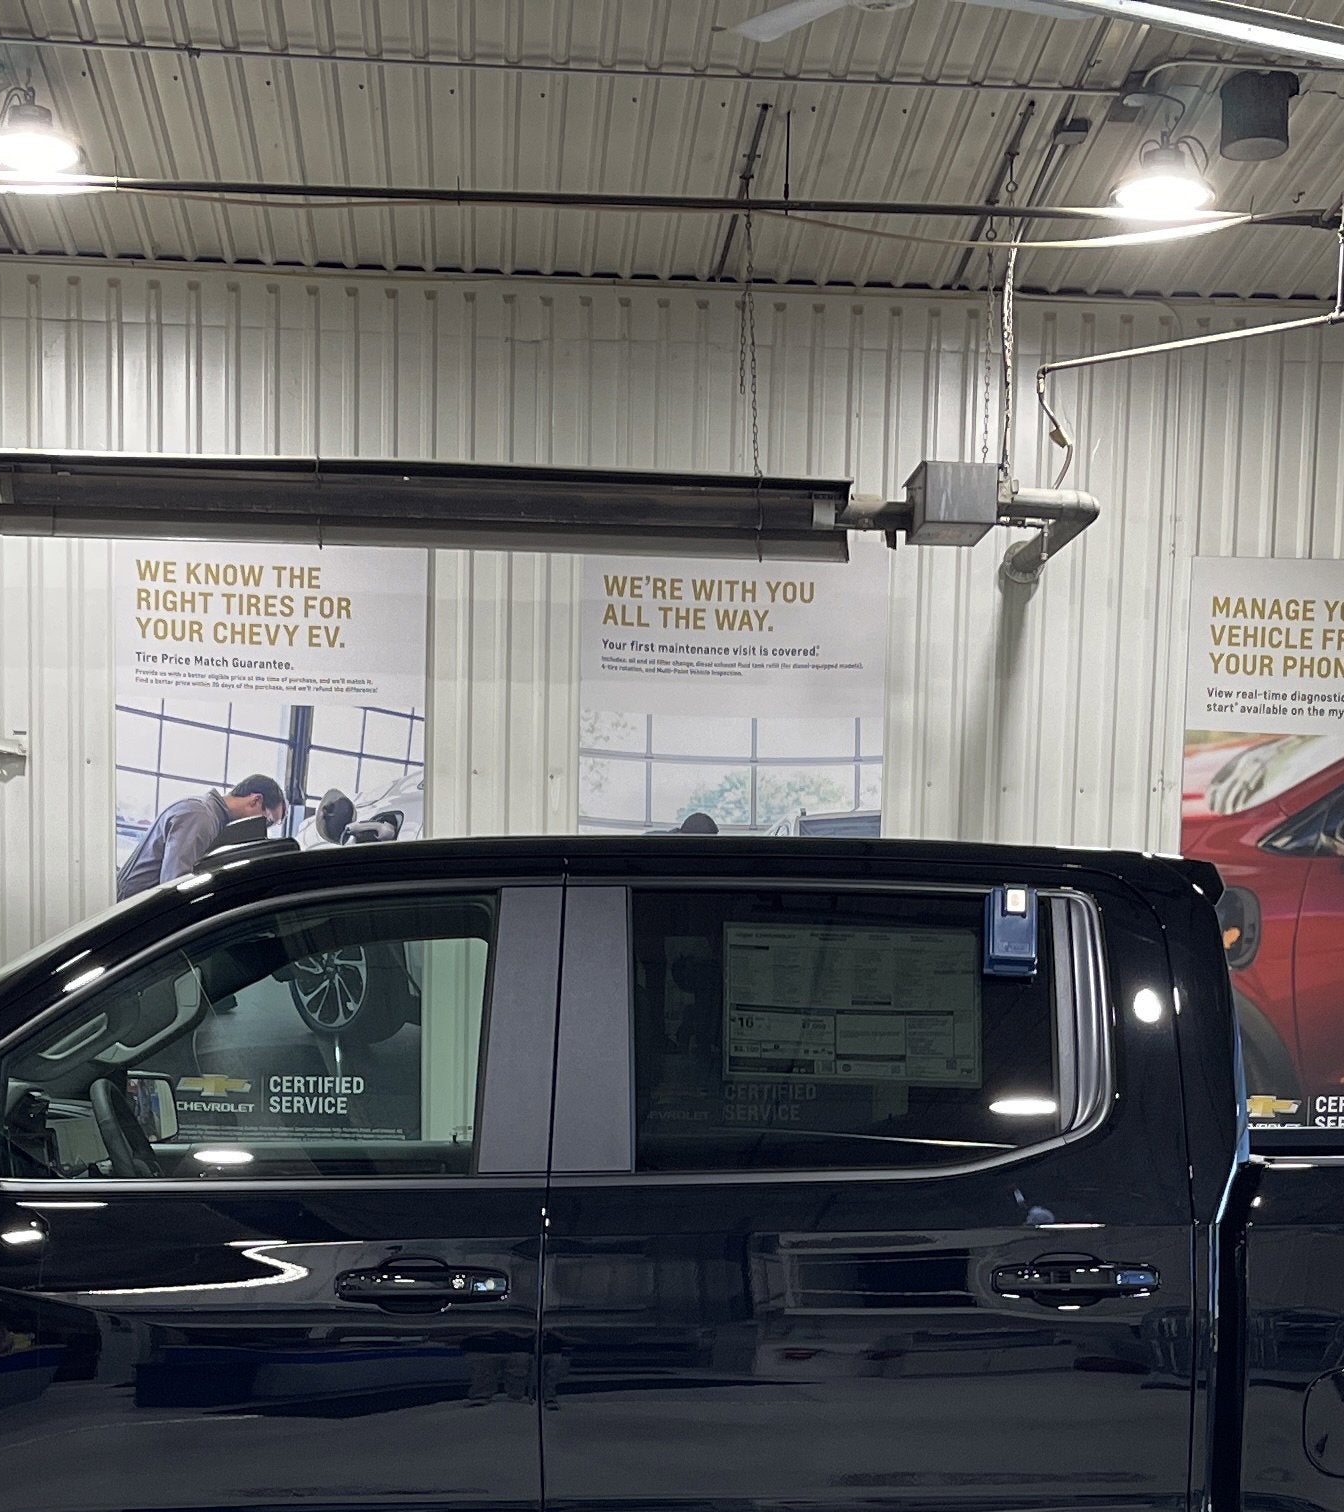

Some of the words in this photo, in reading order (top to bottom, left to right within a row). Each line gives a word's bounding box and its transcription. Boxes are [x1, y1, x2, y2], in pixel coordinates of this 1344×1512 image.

[135, 559, 176, 584] WE
[186, 562, 264, 587] KNOW
[272, 565, 321, 590] THE
[603, 575, 683, 600] WE'RE
[691, 578, 757, 603] WITH
[765, 580, 815, 604] YOU
[136, 588, 214, 615] RIGHT
[221, 592, 294, 618] TIRES
[304, 595, 352, 620] FOR
[1211, 596, 1316, 621] MANAGE
[602, 603, 650, 628] ALL
[658, 606, 706, 630] THE
[714, 608, 774, 632] WAY.
[135, 617, 204, 643] YOUR
[212, 621, 300, 647] CHEVY
[308, 625, 345, 648] EV.
[1210, 624, 1313, 650] VEHICLE
[602, 638, 627, 651] Your
[630, 641, 655, 652] first
[658, 642, 730, 655] maintenance
[733, 645, 756, 656] visit
[759, 645, 768, 656] is
[136, 652, 157, 663] Tire
[161, 653, 191, 665] Price
[194, 656, 228, 668] Match
[232, 657, 294, 670] Guarantee.
[1208, 652, 1273, 677] YOUR
[1206, 687, 1233, 700] View
[1236, 689, 1288, 702] real-time
[1240, 703, 1288, 716] available
[1291, 707, 1304, 716] on
[1307, 705, 1325, 717] the
[269, 1076, 364, 1094] CERTIFIED
[725, 1084, 817, 1101] CERTIFIED
[269, 1096, 348, 1115] SERVICE
[724, 1104, 801, 1121] SERVICE
